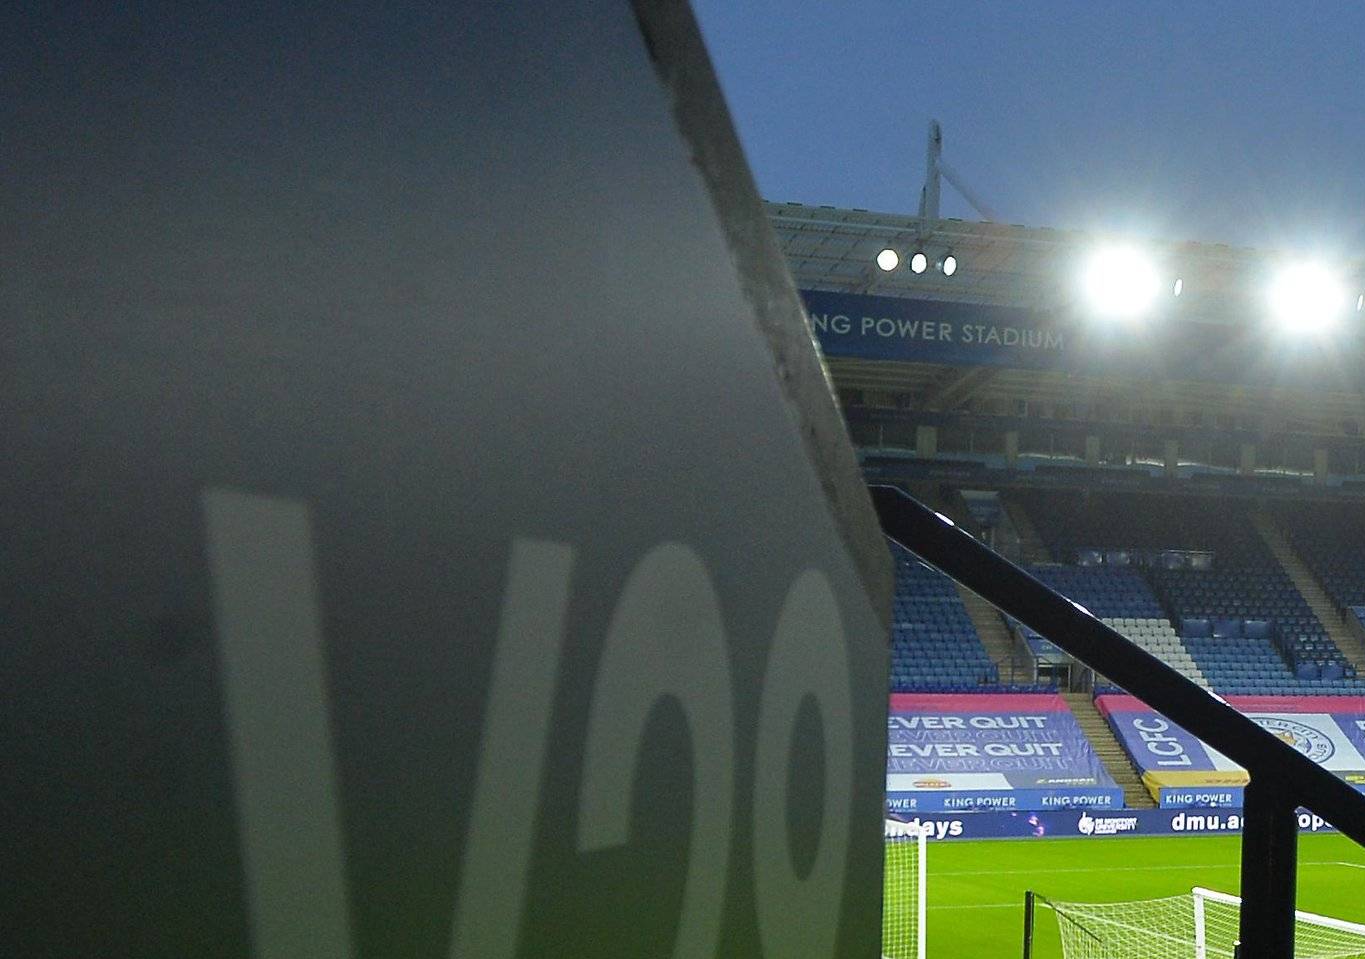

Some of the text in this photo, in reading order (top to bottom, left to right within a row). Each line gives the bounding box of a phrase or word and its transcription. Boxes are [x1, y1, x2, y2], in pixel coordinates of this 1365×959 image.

[861, 317, 952, 342] POWER
[962, 324, 1064, 350] STADIUM
[970, 716, 1047, 729] QUIT
[1132, 718, 1193, 767] LCFC
[889, 743, 1063, 757] EVER QUIT
[944, 797, 1016, 807] KING POWER
[1042, 795, 1111, 805] KING POWER
[1166, 794, 1233, 804] KING POWER
[1172, 813, 1244, 831] dmu.a
